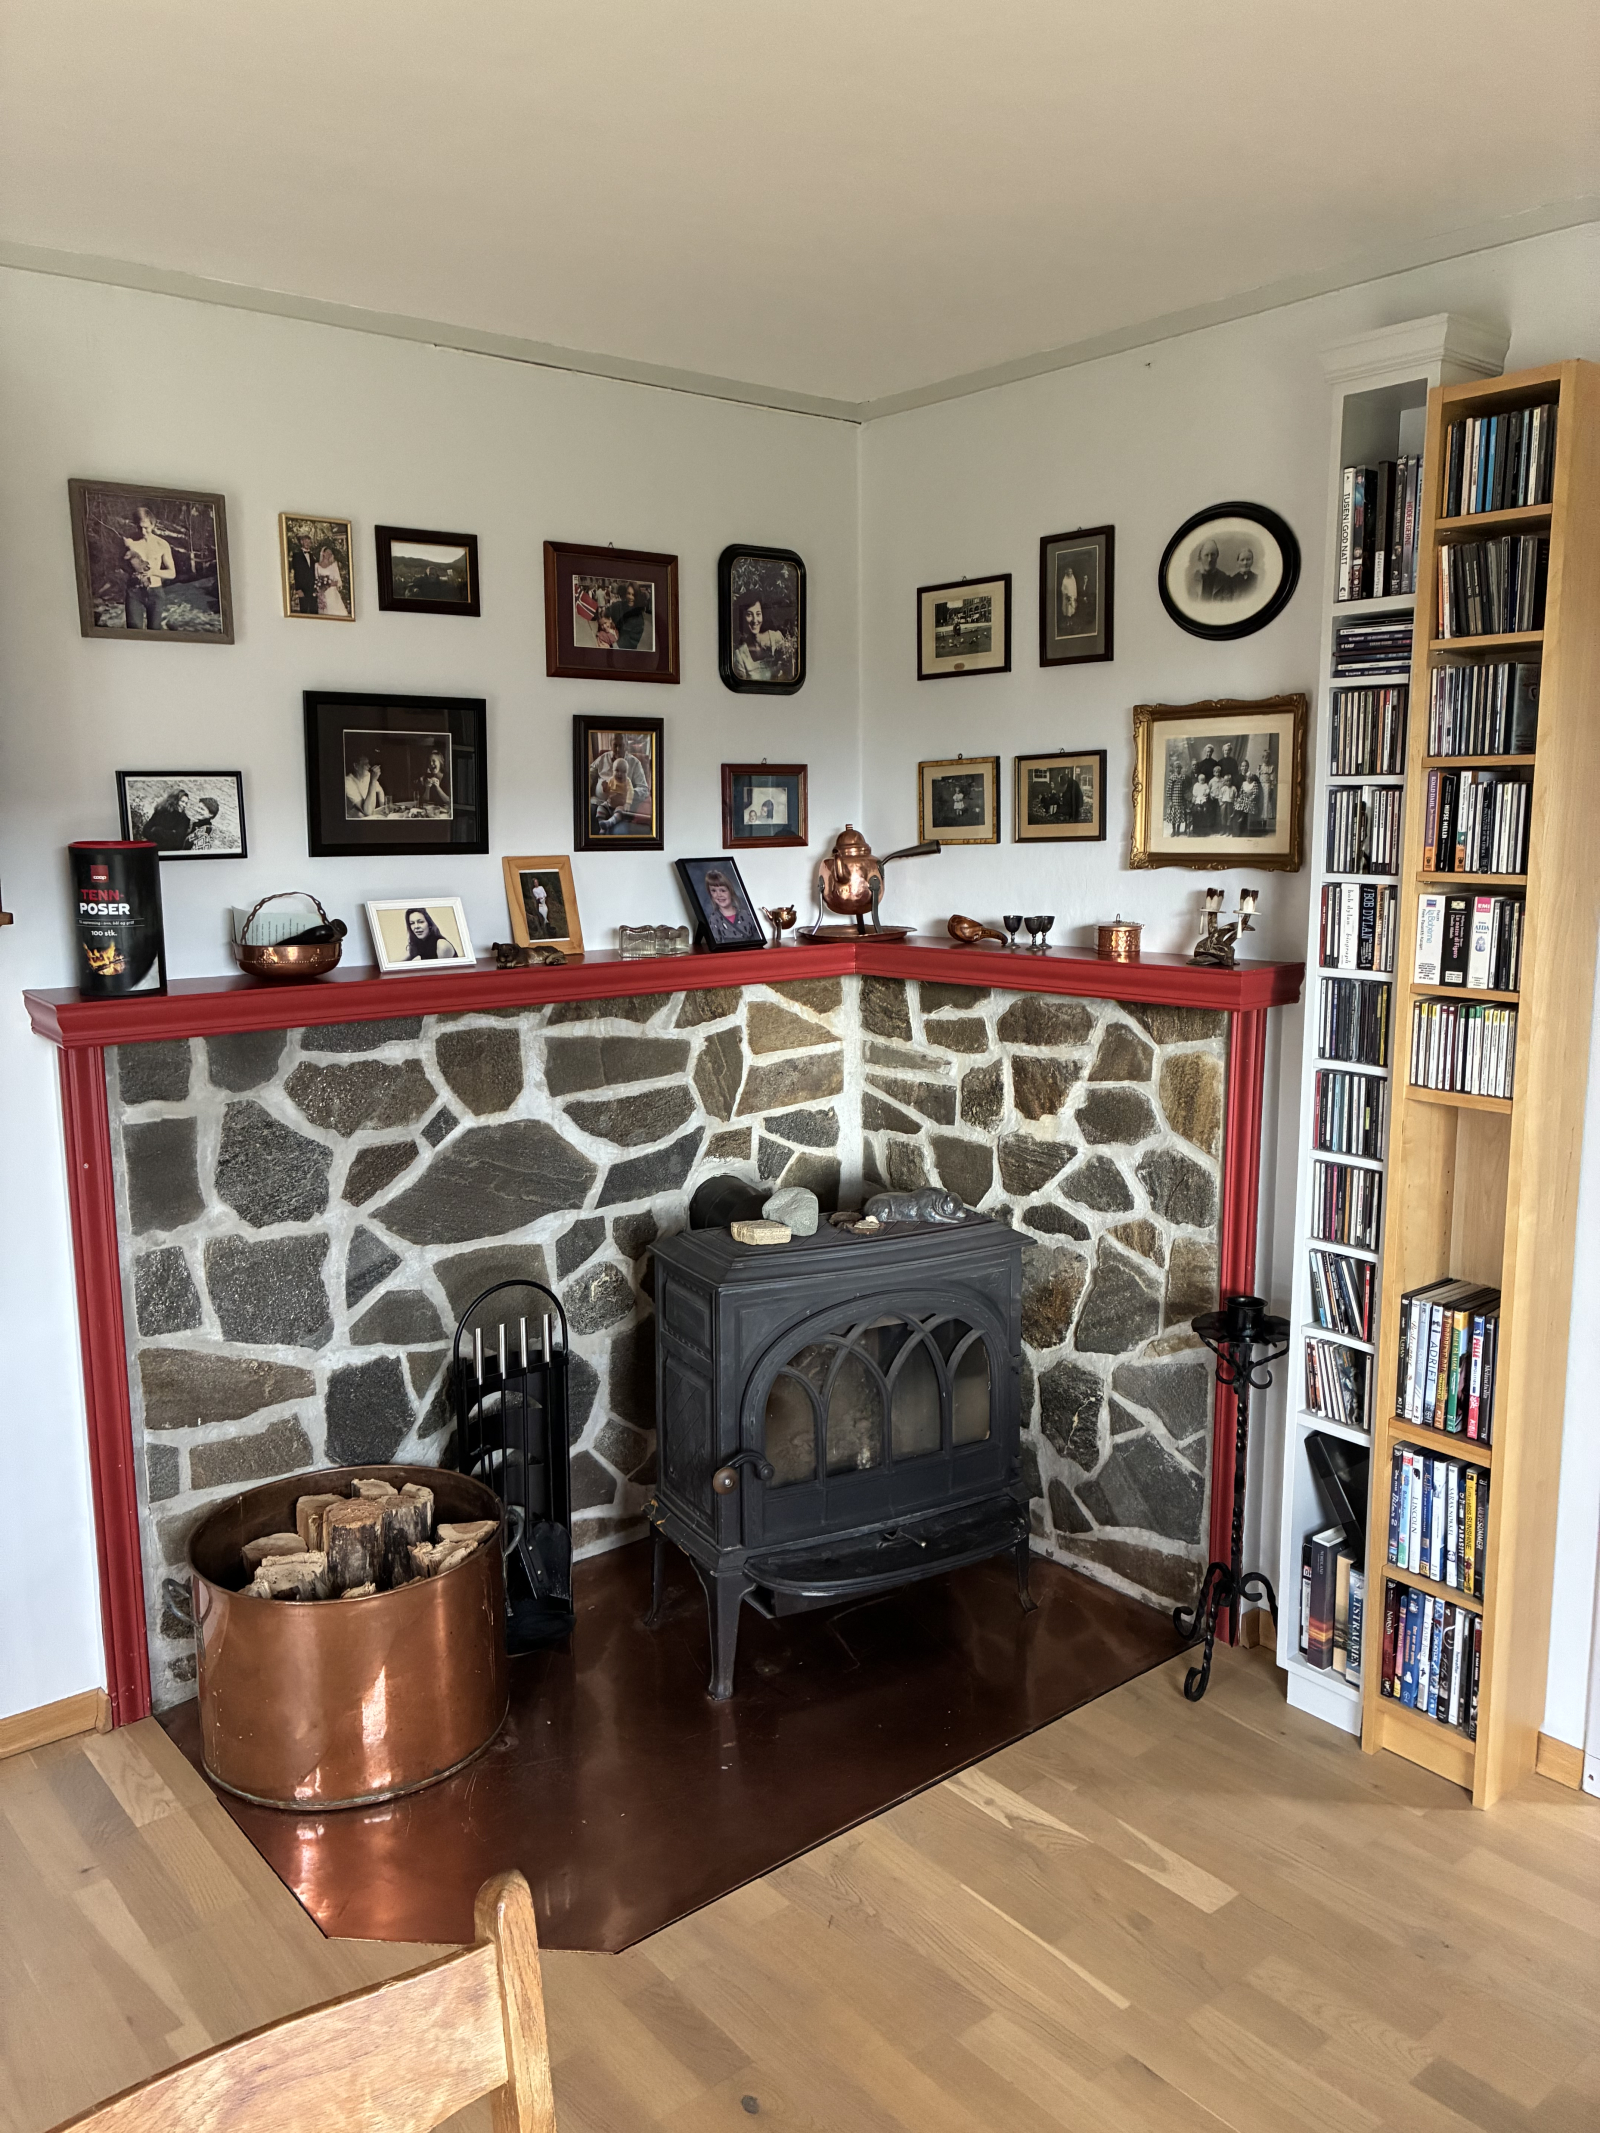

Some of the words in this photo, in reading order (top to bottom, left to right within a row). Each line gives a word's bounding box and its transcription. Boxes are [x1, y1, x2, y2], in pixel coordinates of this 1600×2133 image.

[1343, 492, 1351, 521] TUSEN
[79, 902, 130, 915] POSER
[80, 889, 124, 901] TENN-
[1363, 893, 1374, 908] BOB
[1345, 905, 1353, 925] dylan
[1361, 909, 1373, 939] DYLAN
[1472, 1337, 1481, 1358] PELLE
[1428, 1341, 1438, 1384] ADRIFT
[1391, 1518, 1398, 1527] 2
[1411, 1496, 1419, 1534] LINCOLN
[1476, 1506, 1485, 1550] ULVESOMMER
[1465, 1516, 1474, 1550] SUNSHINE
[1350, 1582, 1363, 1667] SALTSTRAUMEN
[1385, 1610, 1394, 1635] NARNIA
